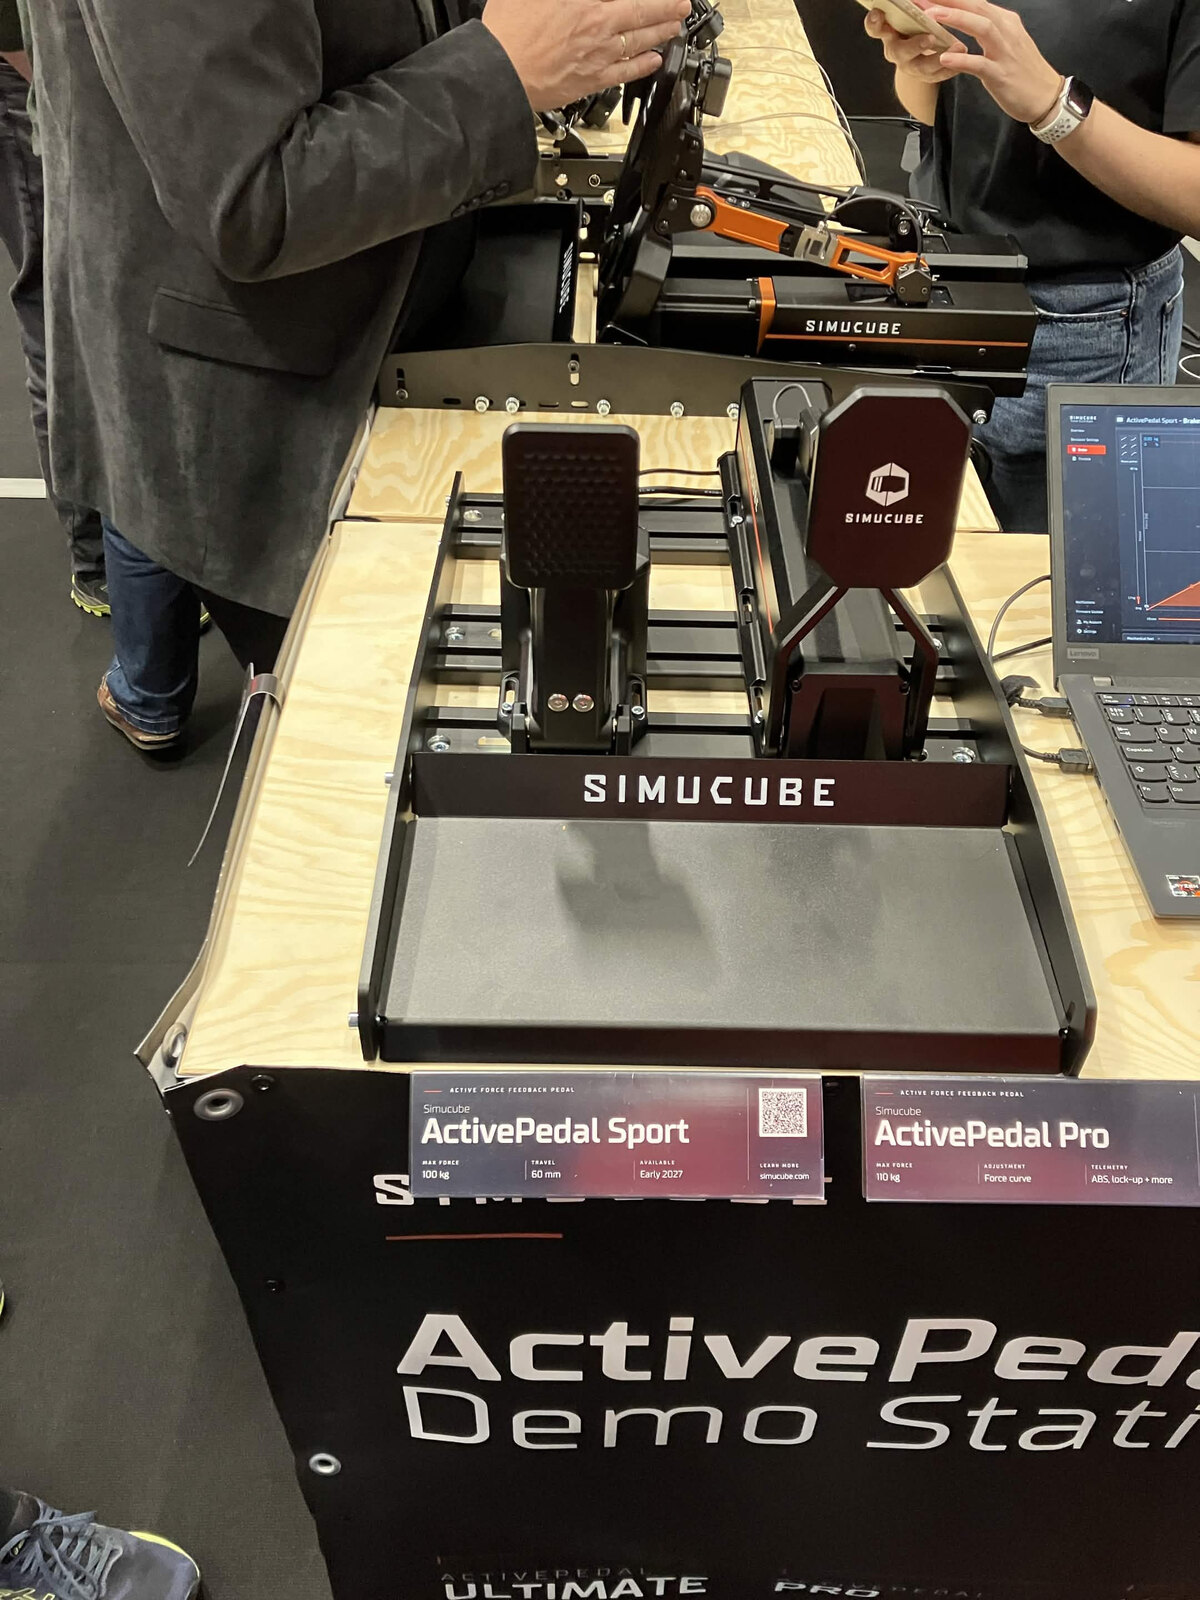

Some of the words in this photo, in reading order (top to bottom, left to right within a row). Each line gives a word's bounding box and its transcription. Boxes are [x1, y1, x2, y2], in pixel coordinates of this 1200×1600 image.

[805, 320, 902, 335] SIMUCUBE
[845, 513, 924, 524] SIMUCUBE
[584, 774, 836, 807] SIMUCUBE
[423, 1103, 470, 1114] Simucube
[875, 1106, 922, 1116] Simucube
[420, 1117, 601, 1144] ActivePedal
[608, 1117, 690, 1149] Sport
[874, 1119, 1052, 1148] ActivePedal
[1059, 1121, 1110, 1149] Pro
[422, 1170, 437, 1179] 100
[439, 1170, 450, 1180] kg
[531, 1170, 543, 1179] 60
[640, 1170, 661, 1180] Early
[662, 1170, 684, 1179] 2027
[759, 1172, 810, 1180] simucube.com
[876, 1172, 888, 1181] 110
[890, 1172, 901, 1183] kg
[984, 1173, 1007, 1182] Force
[1009, 1175, 1032, 1183] curve
[1091, 1175, 1111, 1184] ABS,
[1112, 1175, 1143, 1185] lock-up
[402, 1385, 817, 1450] Demo
[444, 1576, 708, 1600] ULTIMATE
[774, 1581, 881, 1598] PRO
